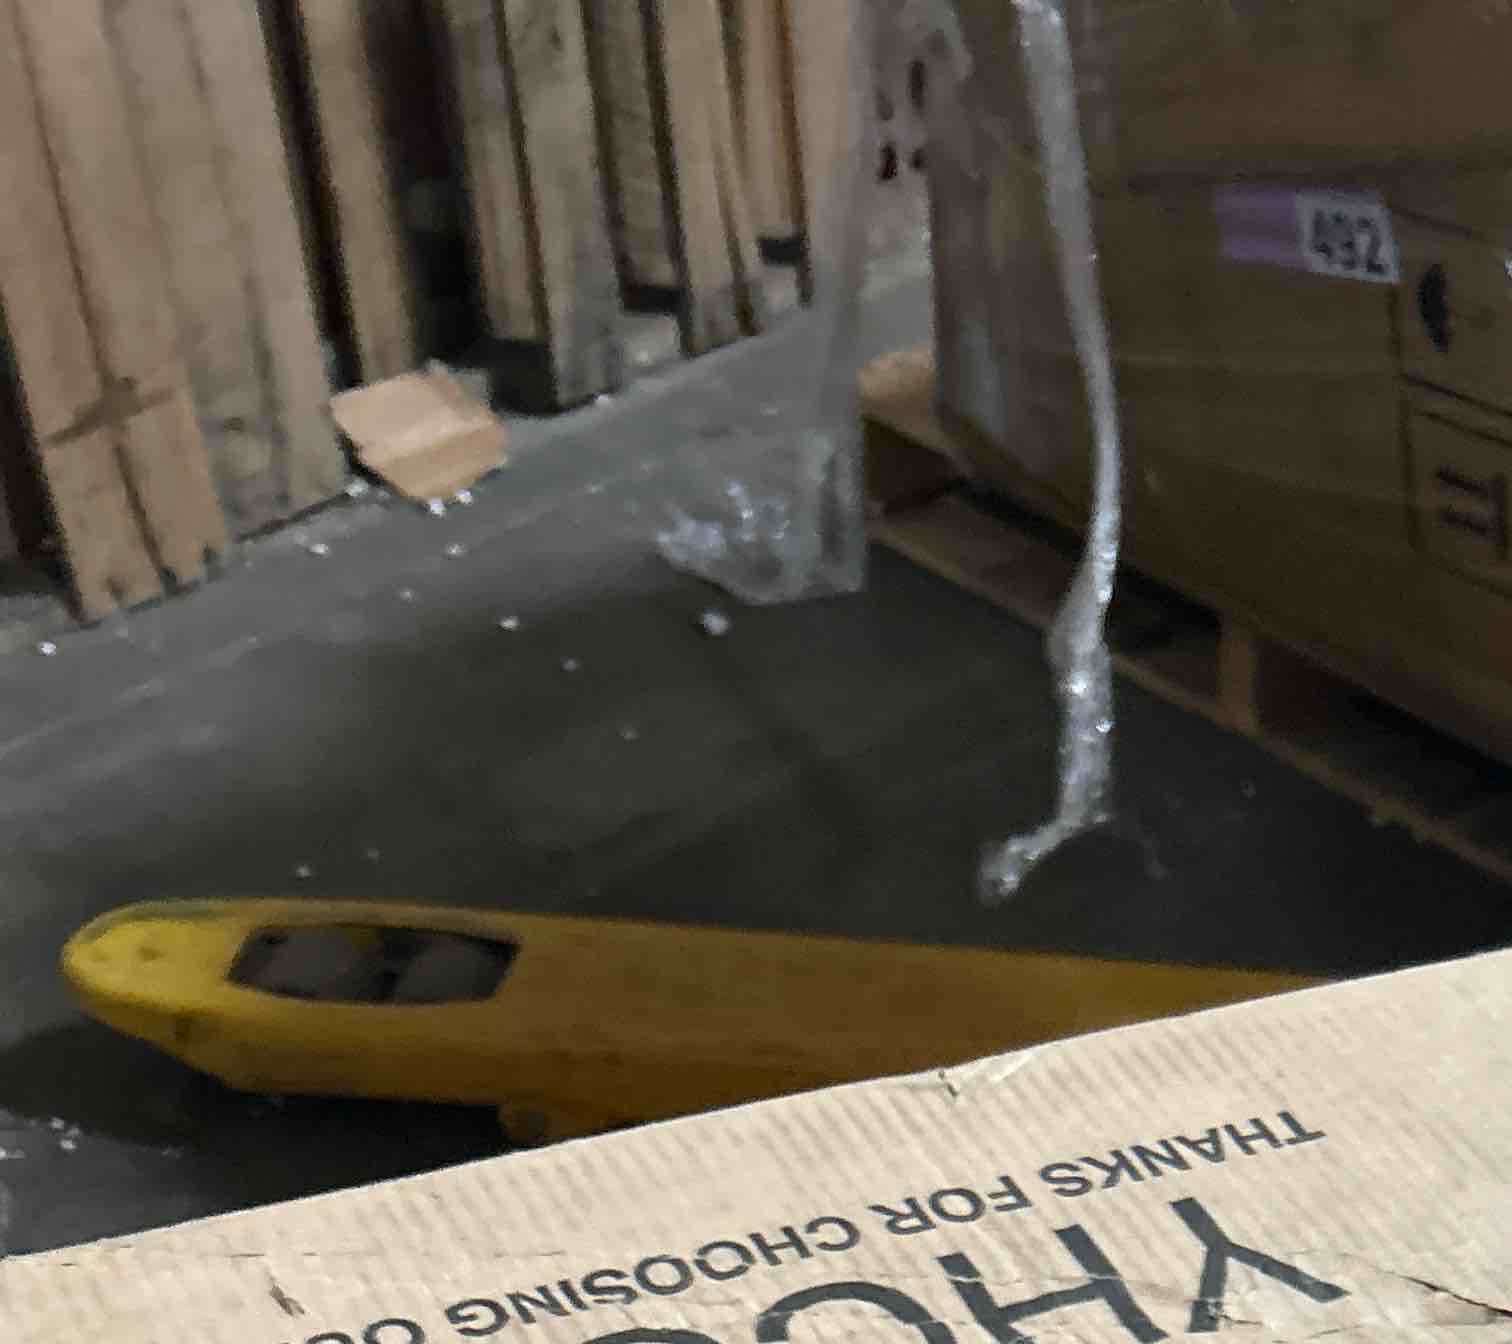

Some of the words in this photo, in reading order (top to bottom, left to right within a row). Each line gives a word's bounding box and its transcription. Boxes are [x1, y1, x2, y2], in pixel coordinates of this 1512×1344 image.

[1312, 208, 1388, 275] 492
[1041, 1110, 1325, 1198] THANKS
[869, 1175, 1035, 1237] FOR
[444, 1216, 861, 1337] CHOOSING
